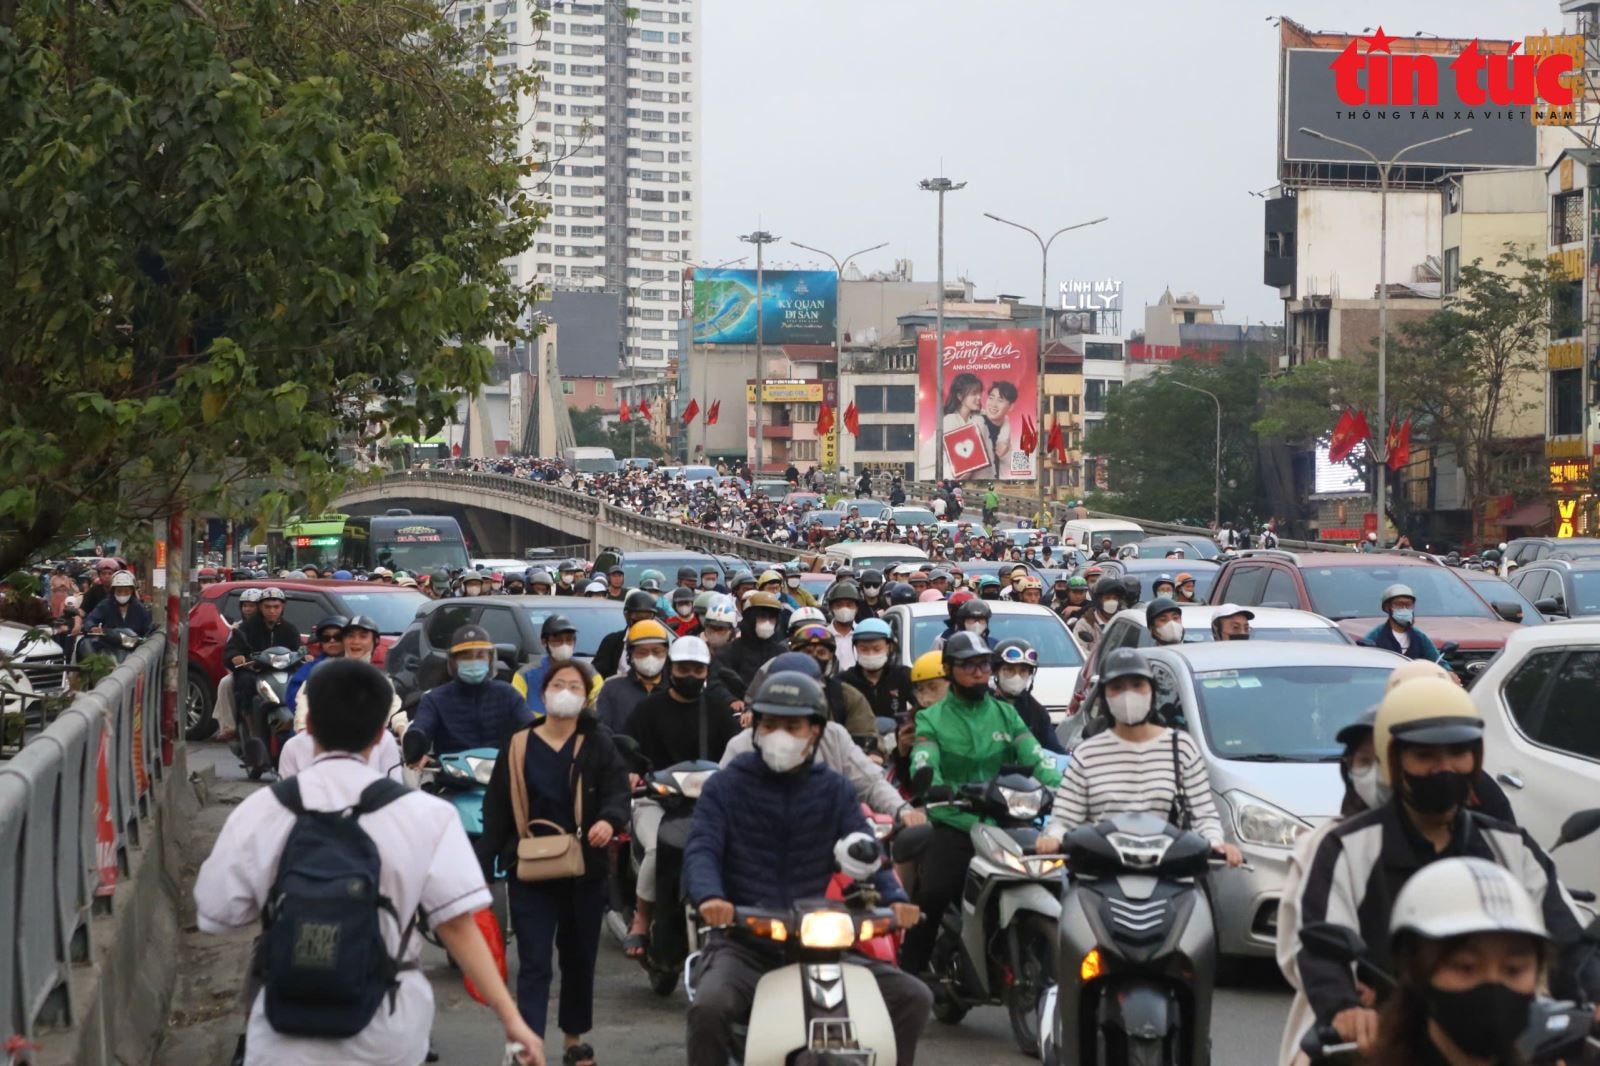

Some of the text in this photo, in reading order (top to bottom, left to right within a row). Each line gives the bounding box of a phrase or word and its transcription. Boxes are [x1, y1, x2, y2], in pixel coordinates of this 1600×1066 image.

[1060, 279, 1091, 292] KÍNH
[794, 299, 825, 310] QUAN
[1062, 294, 1119, 309] LILY
[980, 341, 1020, 359] Quà
